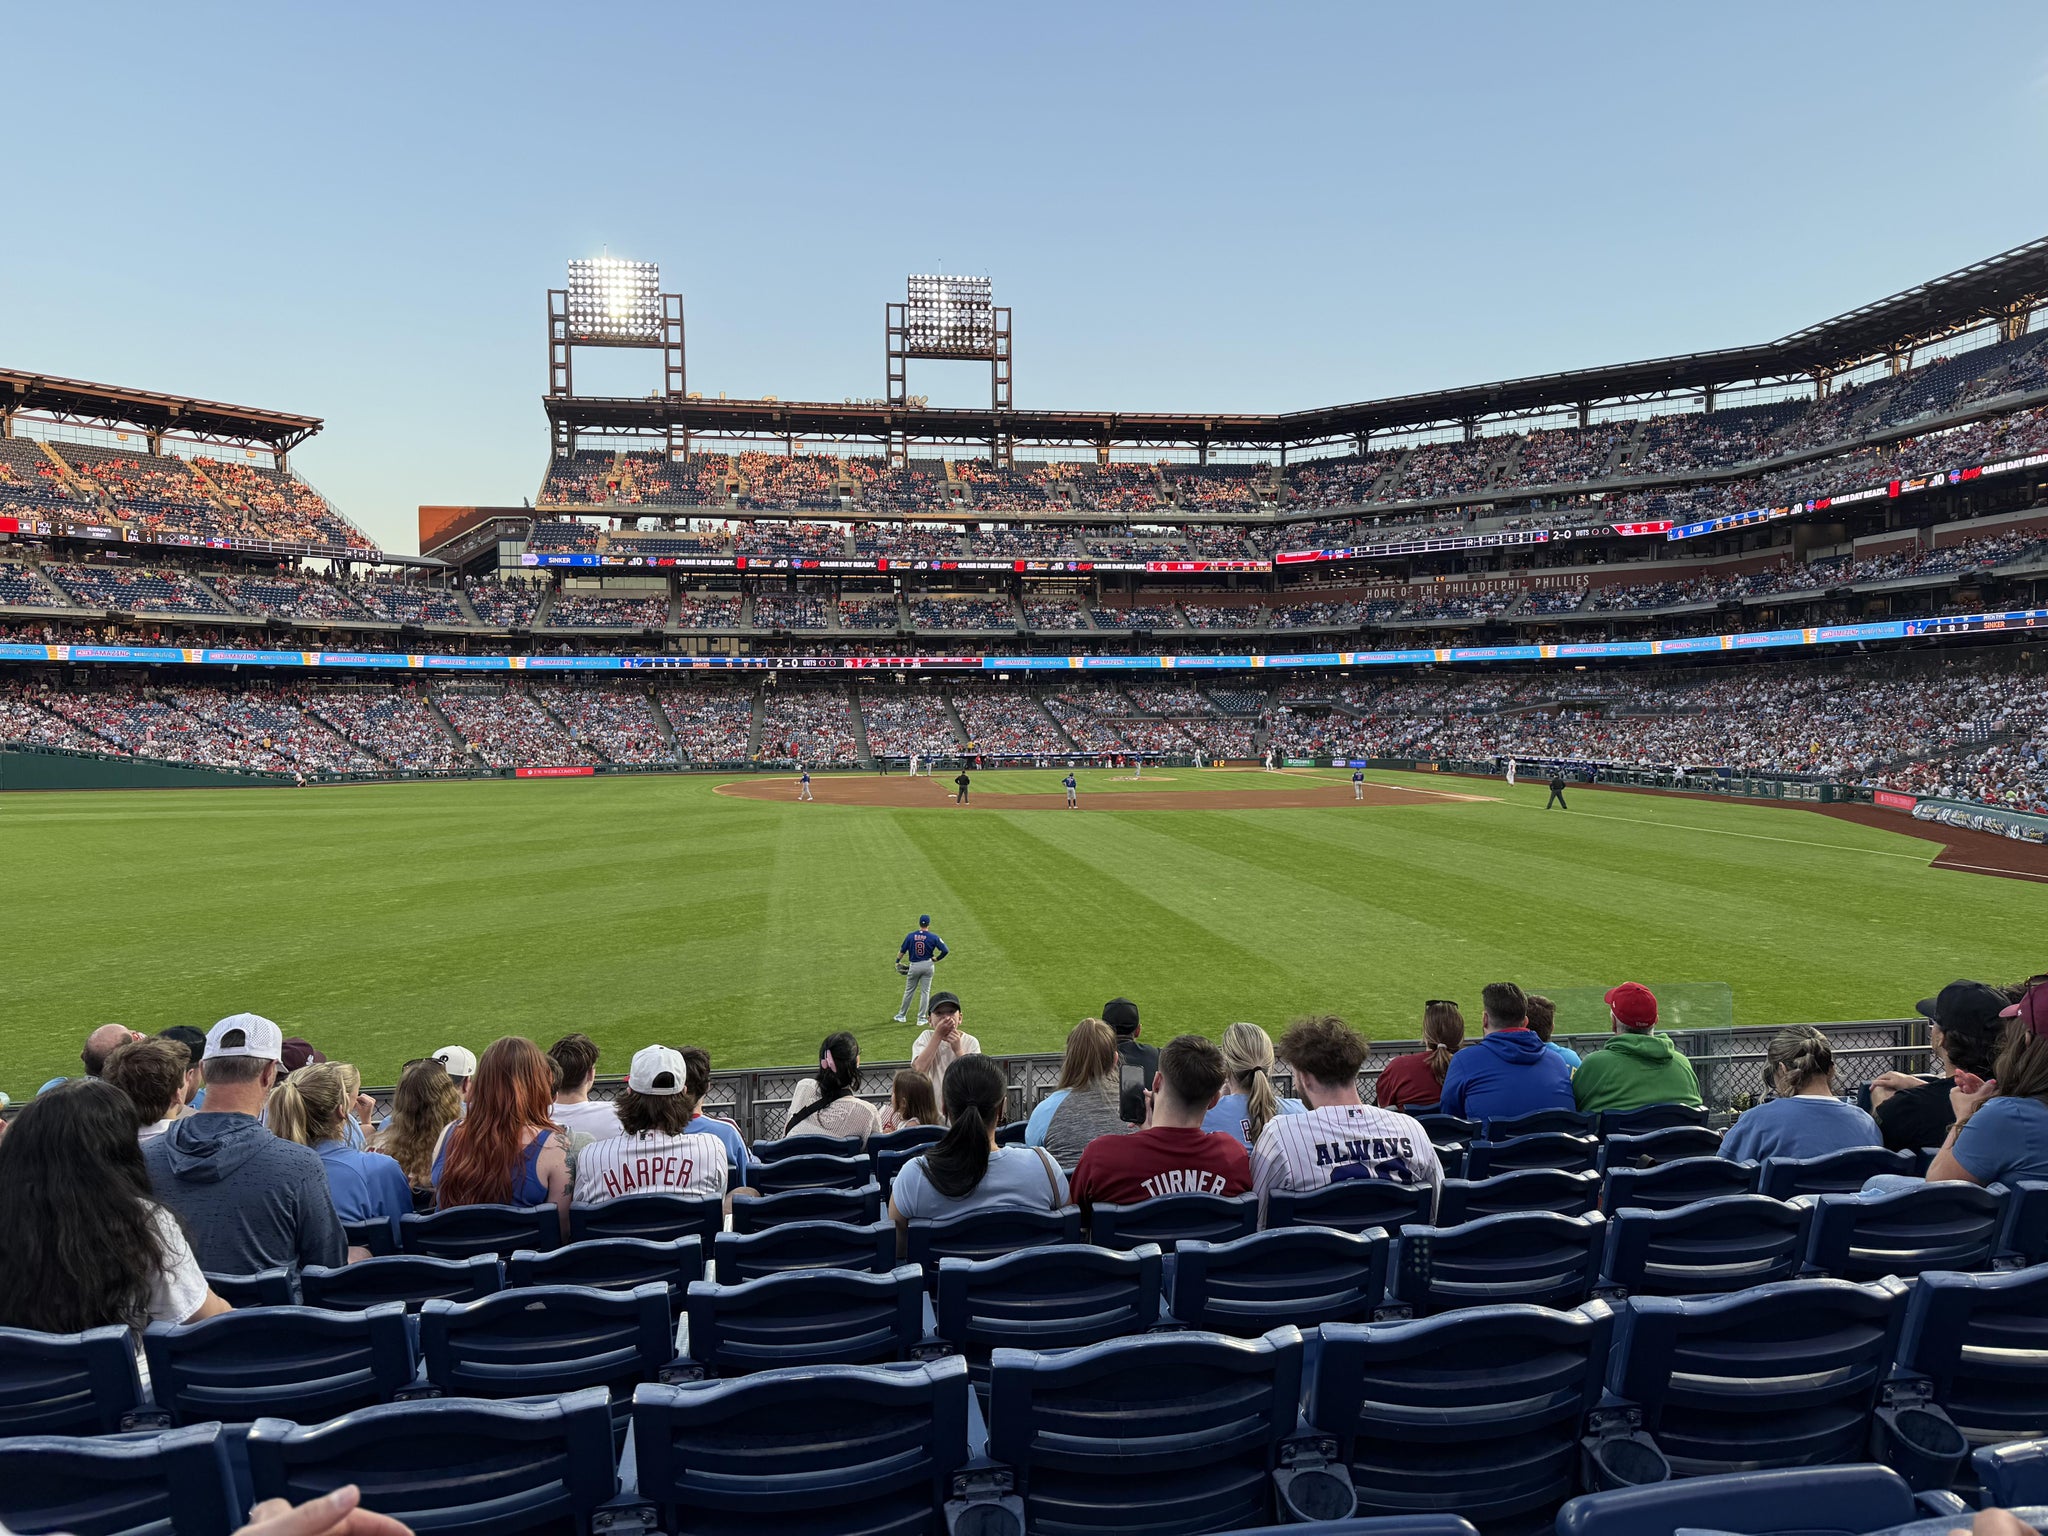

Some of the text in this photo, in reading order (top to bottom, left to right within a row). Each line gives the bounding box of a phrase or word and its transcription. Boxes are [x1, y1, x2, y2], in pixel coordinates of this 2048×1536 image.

[1982, 462, 2006, 474] GAME
[2006, 459, 2024, 469] DAY
[1831, 494, 1850, 504] GAME
[1850, 492, 1864, 500] DAY
[633, 557, 642, 565] 10
[918, 561, 928, 569] 10
[1367, 575, 1589, 598] HOME OF THE PHILADELPHI PHILLIES
[915, 941, 925, 956] 8
[1315, 1138, 1413, 1166] ALWAYS
[603, 1156, 694, 1198] HARPER
[1140, 1169, 1226, 1198] TURNER
